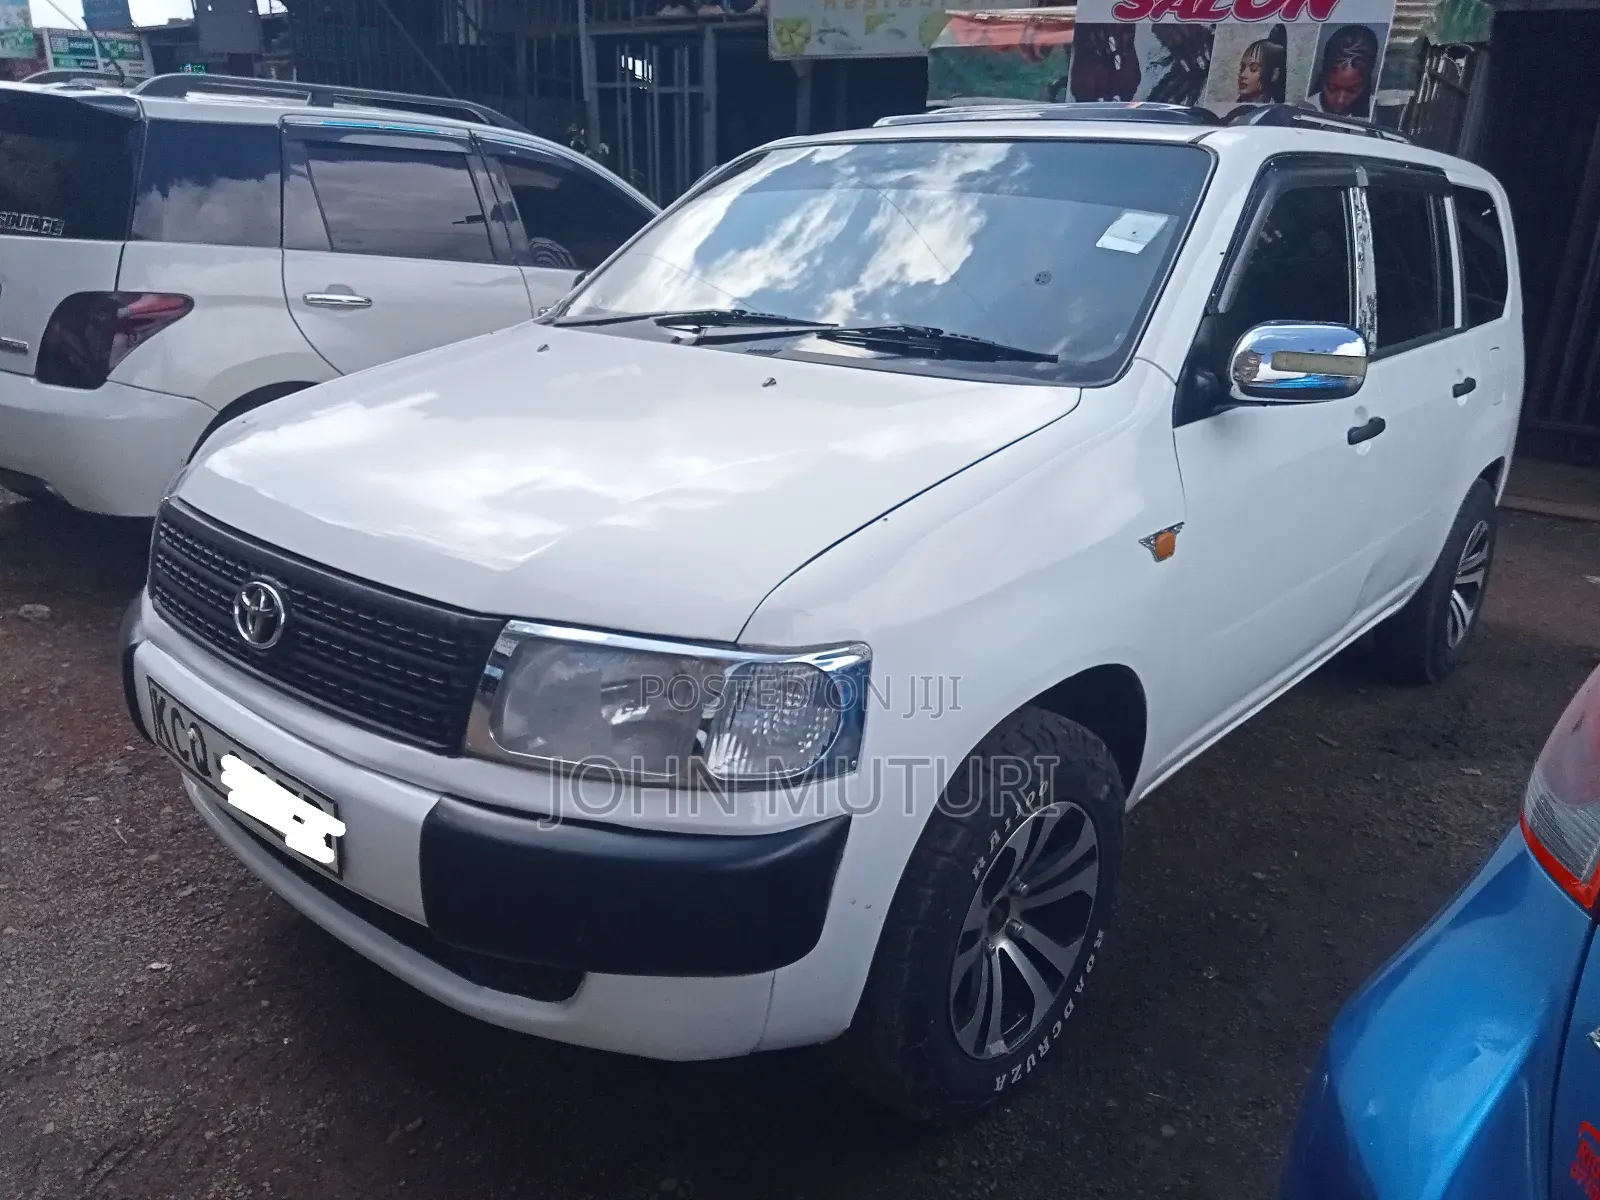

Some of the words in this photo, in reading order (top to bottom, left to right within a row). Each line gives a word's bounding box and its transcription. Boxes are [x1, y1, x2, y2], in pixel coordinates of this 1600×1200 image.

[1111, 0, 1340, 23] SALON
[152, 687, 212, 779] KCQ
[993, 928, 1105, 1092] ROADCRUZA
